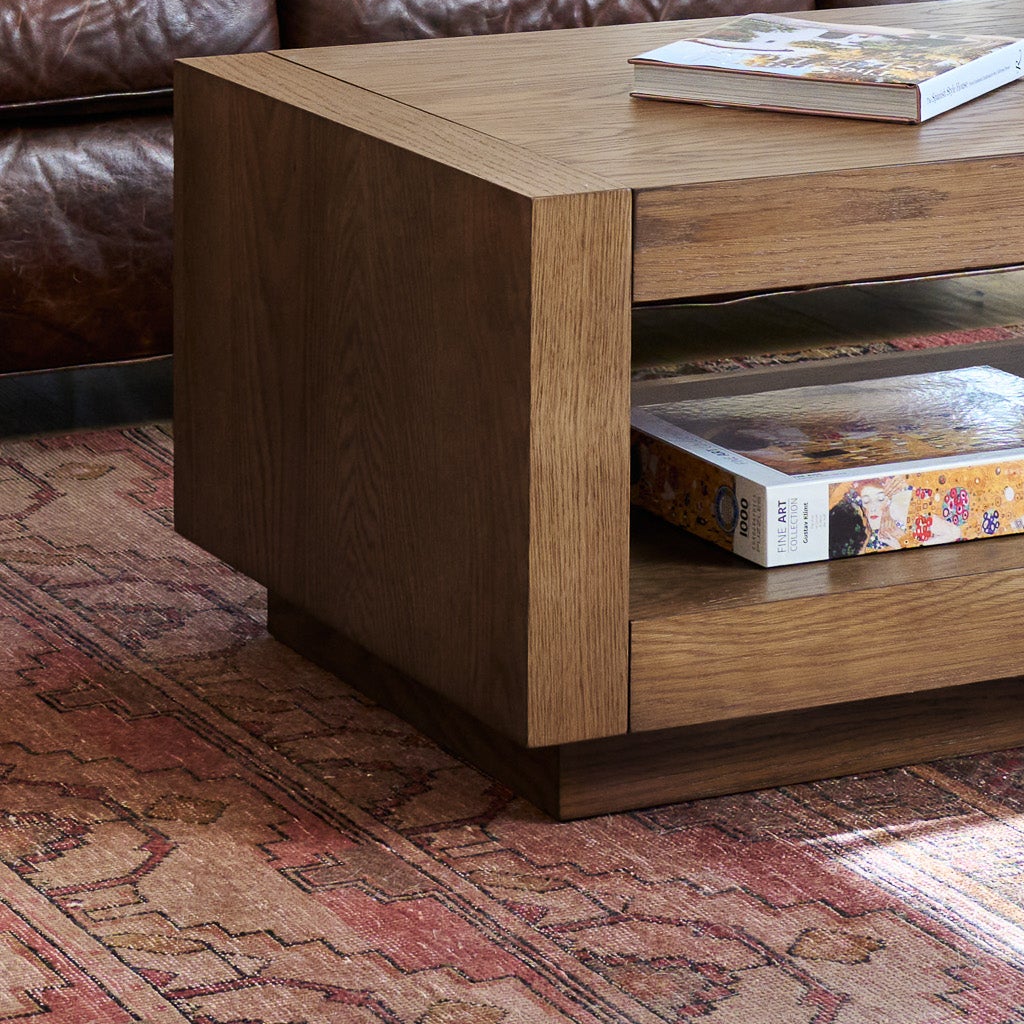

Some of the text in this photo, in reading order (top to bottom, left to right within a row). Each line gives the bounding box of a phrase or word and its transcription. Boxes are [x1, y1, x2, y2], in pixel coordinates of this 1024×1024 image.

[740, 498, 748, 537] 1000
[777, 500, 786, 553] FINE ART
[790, 497, 799, 552] COLLECTION
